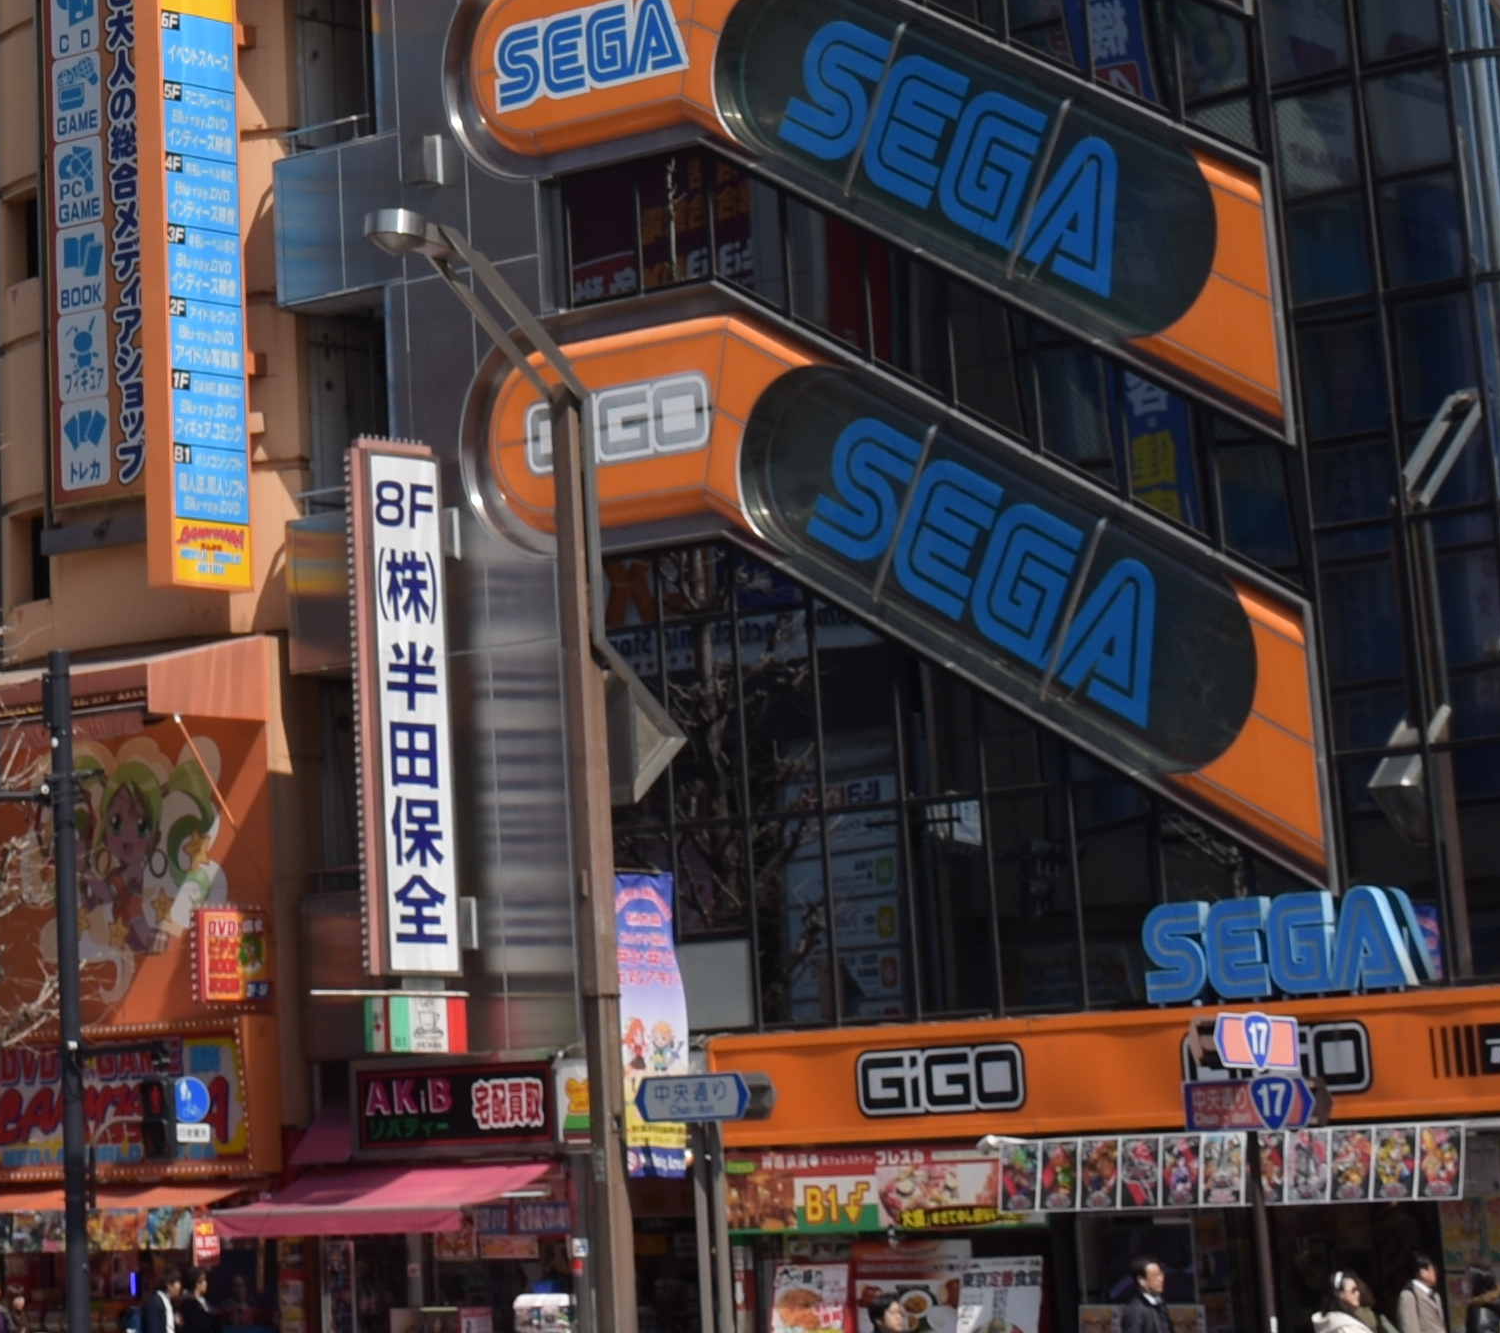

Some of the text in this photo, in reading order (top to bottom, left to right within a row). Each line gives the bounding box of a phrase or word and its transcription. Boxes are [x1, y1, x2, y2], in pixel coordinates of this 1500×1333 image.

[56, 109, 99, 133] GAME
[778, 17, 1119, 299] SEGA
[59, 179, 83, 201] PC
[58, 199, 101, 225] GAME
[60, 283, 103, 309] BOOK
[69, 460, 102, 483] トレカ
[373, 481, 434, 528] 8F
[806, 416, 1157, 728] SEGA
[1143, 884, 1438, 1005] SEGA
[1249, 1021, 1269, 1056] 17
[653, 1080, 728, 1103] 中央通り
[857, 1042, 1027, 1117] GiGO
[472, 1078, 544, 1131] 宅配買取
[1257, 1082, 1286, 1118] 17
[804, 1185, 841, 1225] B1
